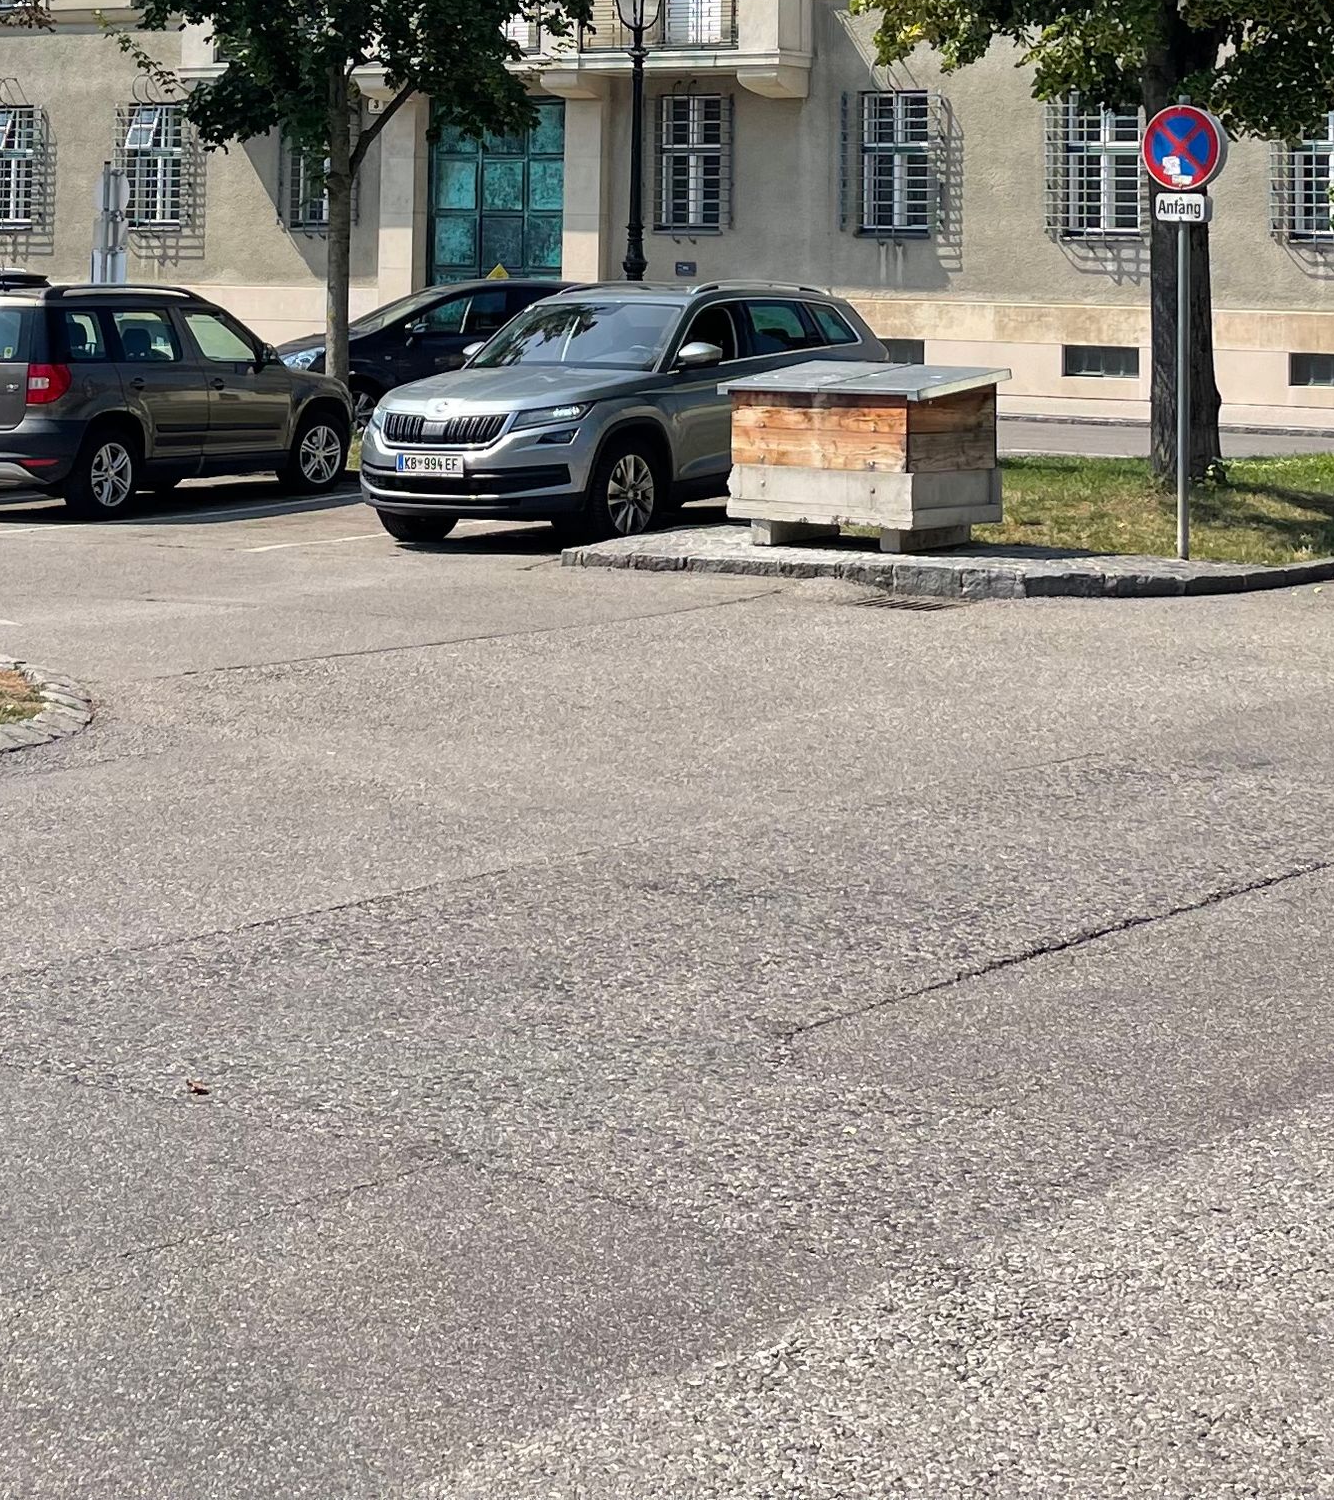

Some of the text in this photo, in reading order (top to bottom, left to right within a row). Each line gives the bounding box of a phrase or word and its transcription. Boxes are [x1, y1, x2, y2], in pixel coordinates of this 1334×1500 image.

[1158, 200, 1201, 219] Anfang
[404, 456, 458, 471] KB 994 EF
